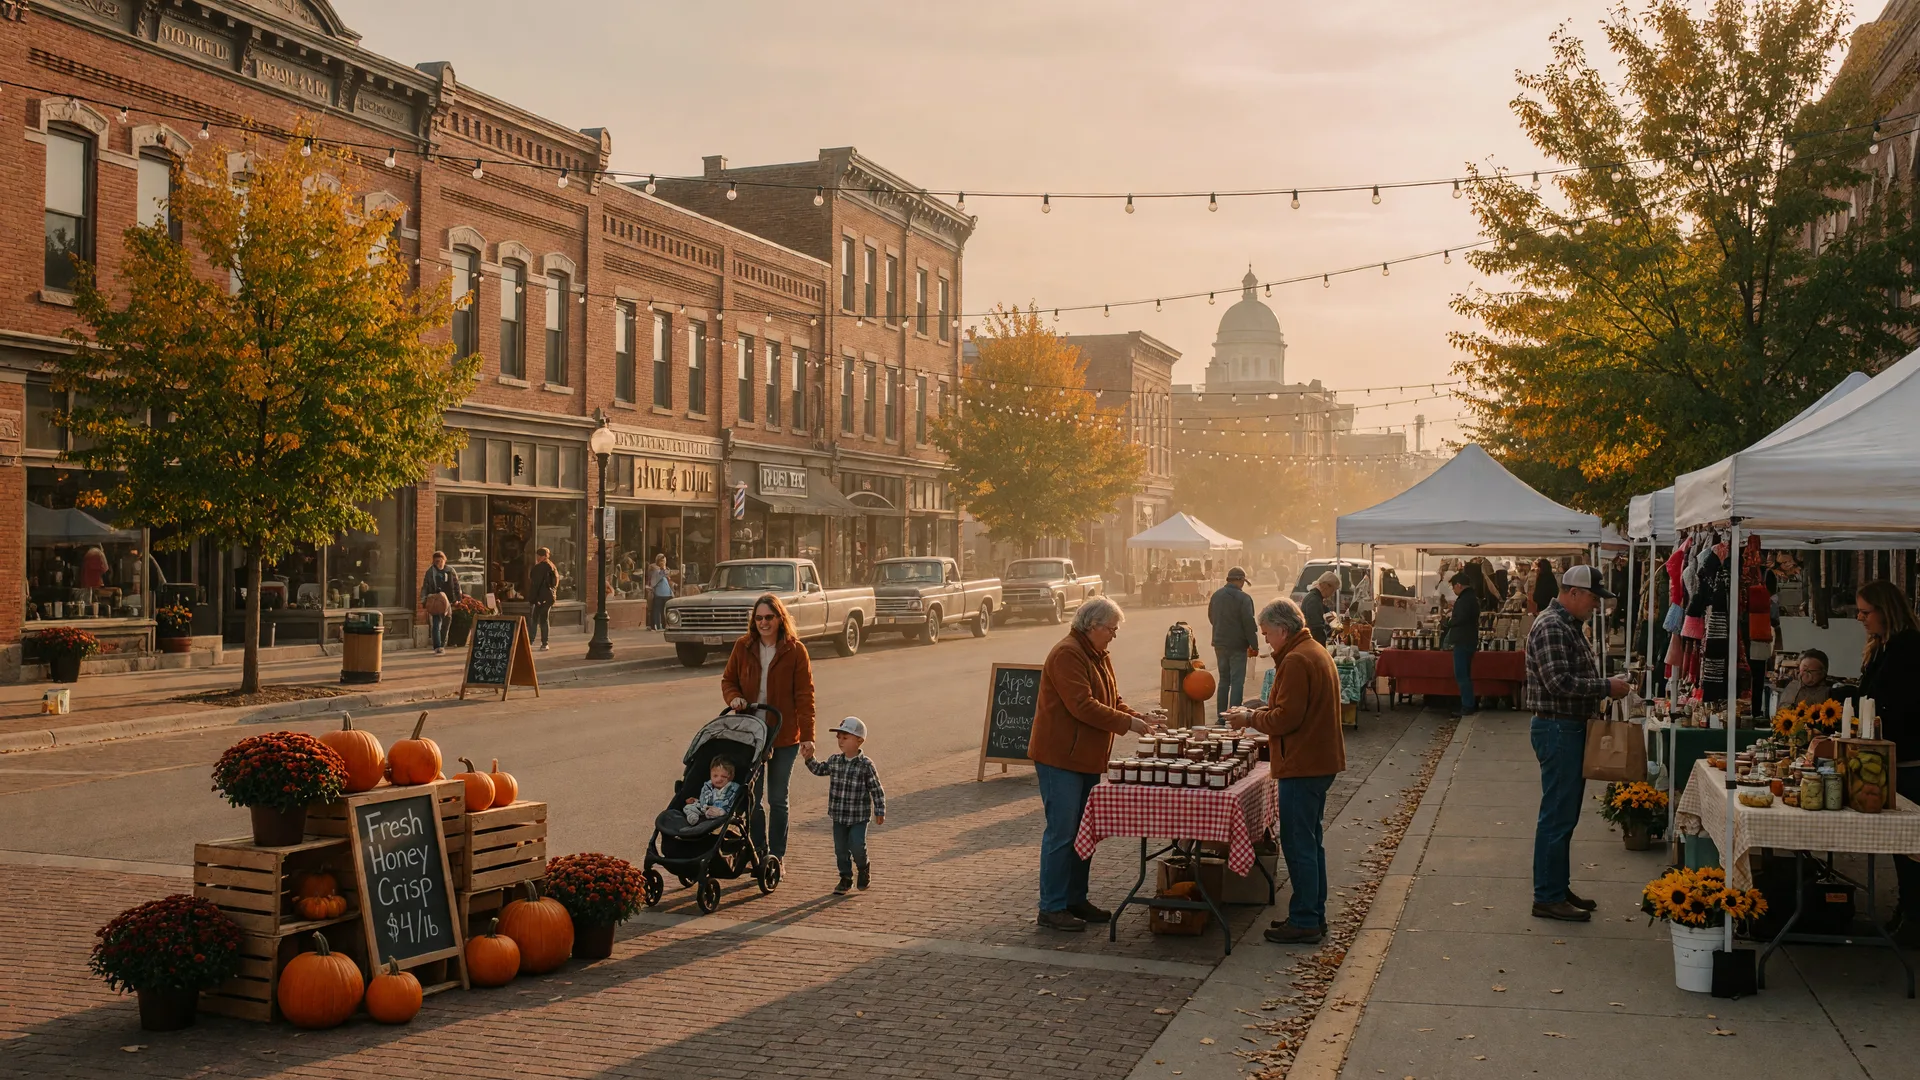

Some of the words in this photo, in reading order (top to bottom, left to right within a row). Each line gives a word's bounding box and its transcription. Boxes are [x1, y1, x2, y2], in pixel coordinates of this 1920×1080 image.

[999, 671, 1034, 691] Apple
[365, 808, 424, 843] Fresh
[369, 843, 429, 875] Honey
[378, 877, 433, 908] Crisp
[386, 909, 439, 943] $4/lb
